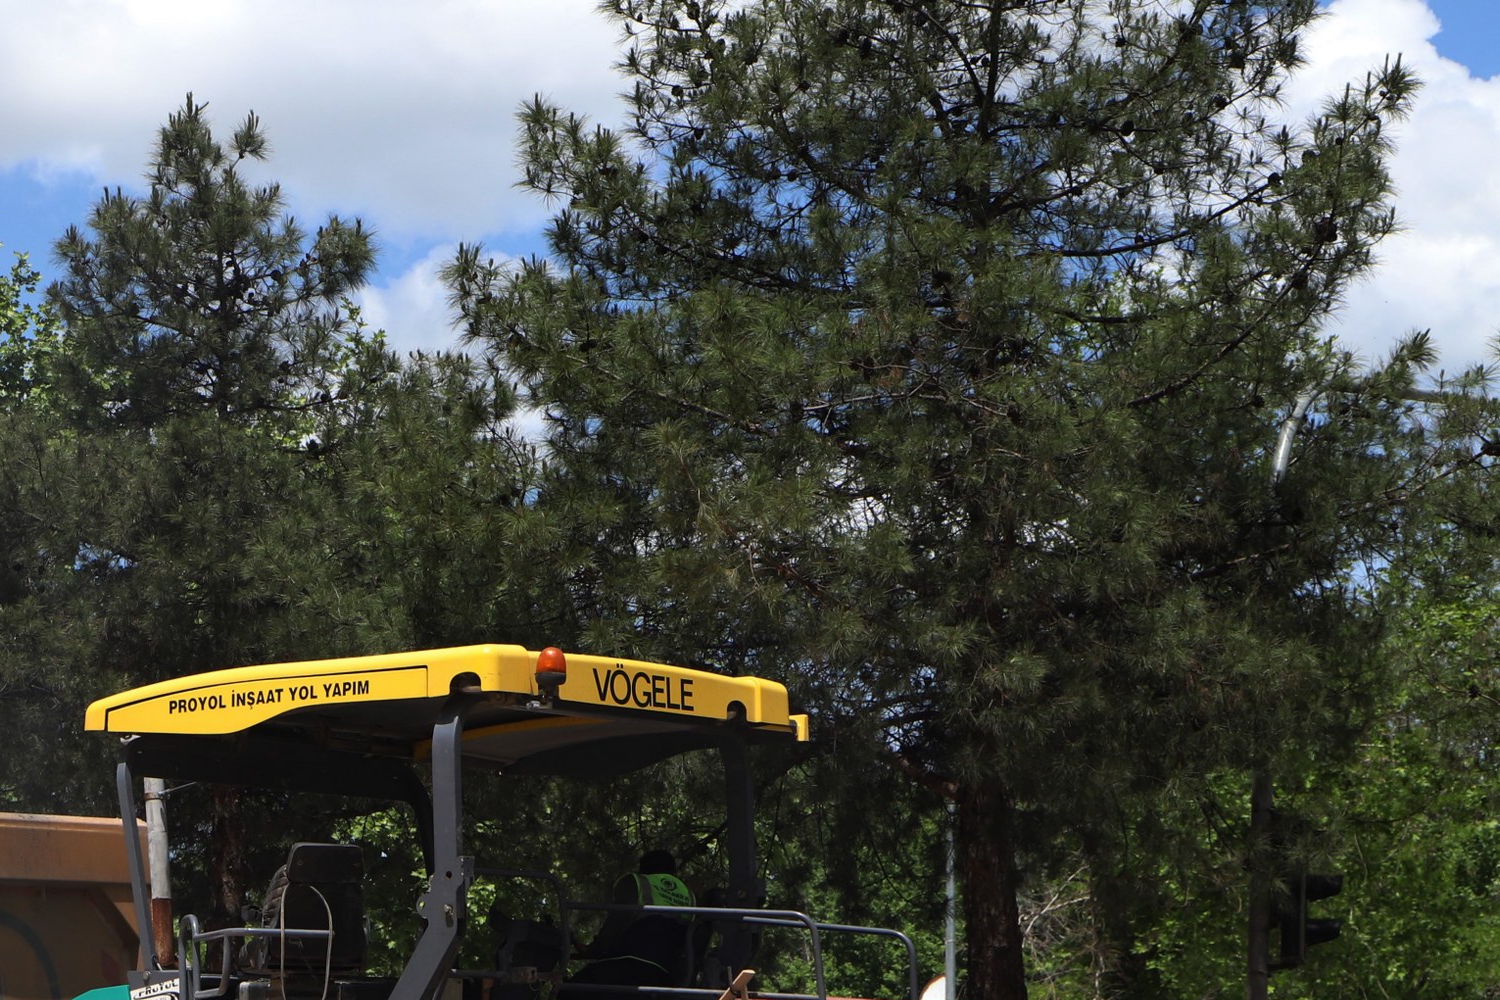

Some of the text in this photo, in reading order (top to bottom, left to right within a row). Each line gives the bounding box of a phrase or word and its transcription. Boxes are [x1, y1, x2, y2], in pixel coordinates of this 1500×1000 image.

[169, 679, 370, 714] PROYOL İNŞAAT YOL YAPIM
[592, 663, 694, 711] VÖGELE
